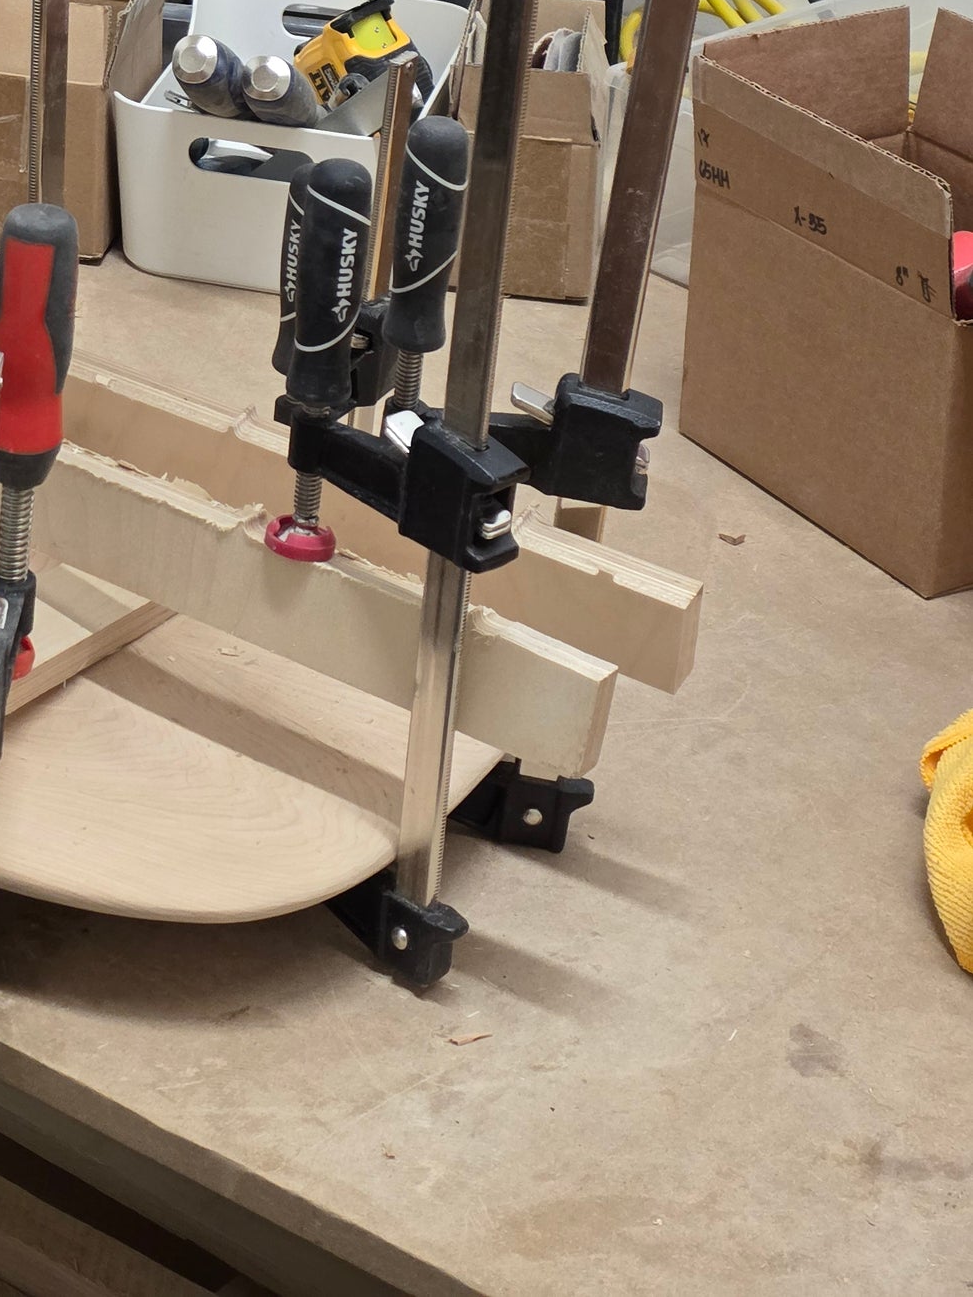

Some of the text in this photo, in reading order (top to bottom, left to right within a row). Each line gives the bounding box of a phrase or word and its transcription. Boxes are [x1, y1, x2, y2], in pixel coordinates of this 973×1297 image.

[407, 179, 430, 249] HUSKY
[286, 219, 302, 281] HUSKY
[336, 228, 358, 298] HUSKY
